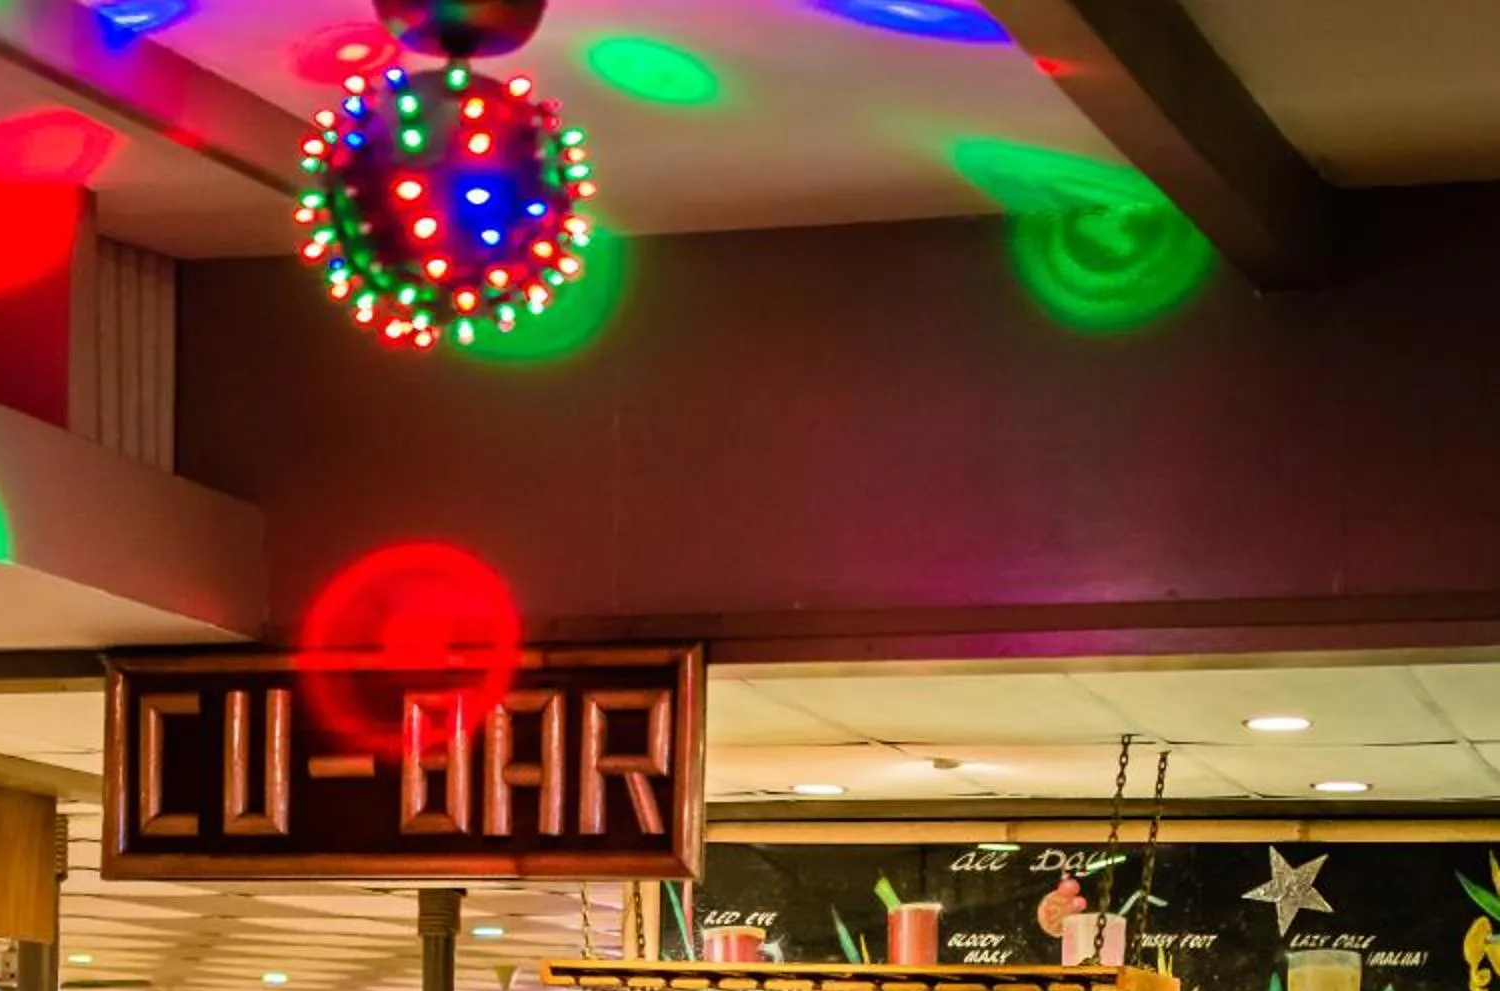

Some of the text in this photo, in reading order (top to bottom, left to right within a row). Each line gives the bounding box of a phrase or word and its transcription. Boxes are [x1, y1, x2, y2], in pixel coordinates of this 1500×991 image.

[703, 910, 741, 925] RED
[947, 933, 1005, 948] BLOODY
[1180, 932, 1219, 949] FOOT
[1289, 933, 1331, 948] LAZY
[963, 950, 1013, 965] MARY
